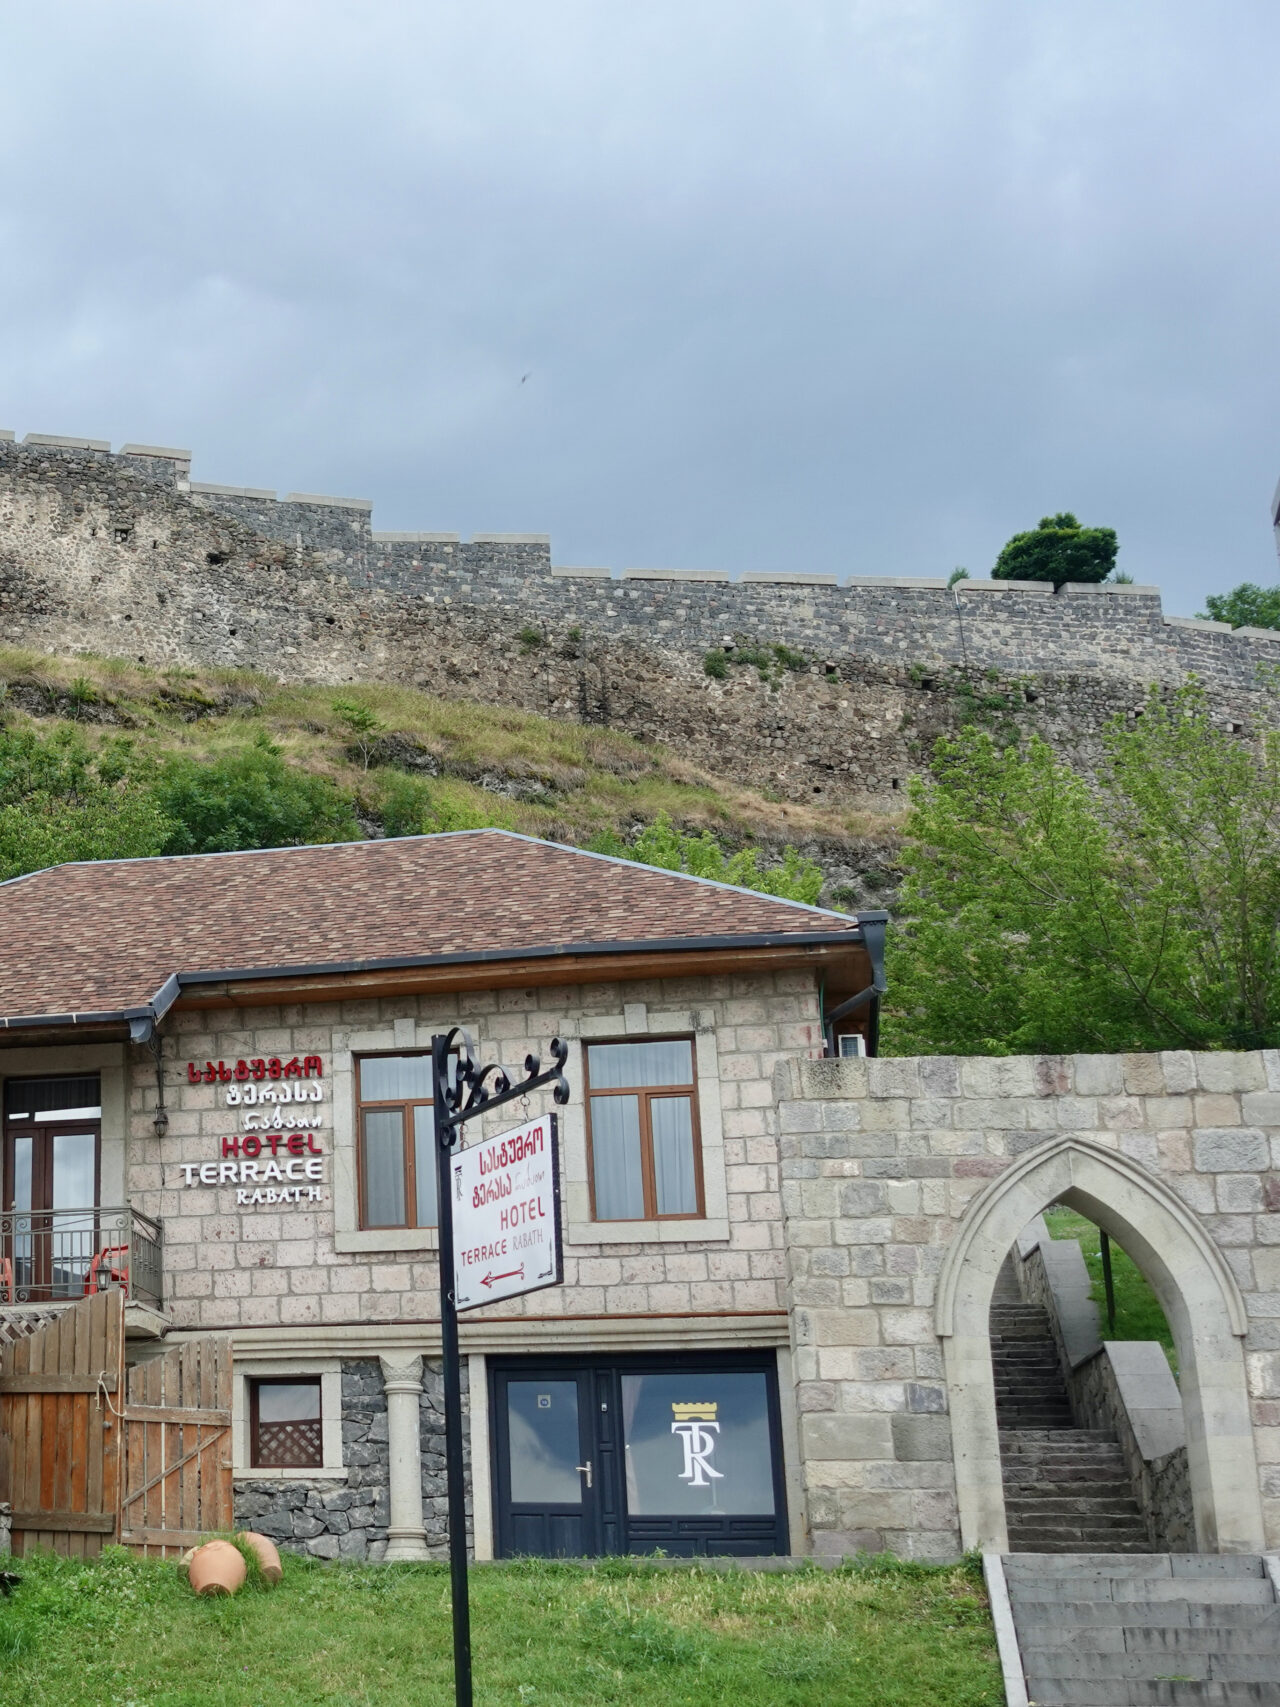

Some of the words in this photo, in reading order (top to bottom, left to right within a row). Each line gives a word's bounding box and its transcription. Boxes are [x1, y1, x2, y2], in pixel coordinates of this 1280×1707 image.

[188, 1056, 322, 1083] სასტუმრო
[226, 1081, 322, 1105] ტერასა
[222, 1133, 322, 1158] HOTEL
[479, 1126, 544, 1176] სასტუმრო
[180, 1158, 322, 1185] TERRACE
[236, 1186, 322, 1205] RABATH
[473, 1173, 512, 1208] ტერასა
[500, 1196, 546, 1231] HOTEL
[461, 1239, 508, 1267] TERRACE
[512, 1227, 544, 1251] RABATH
